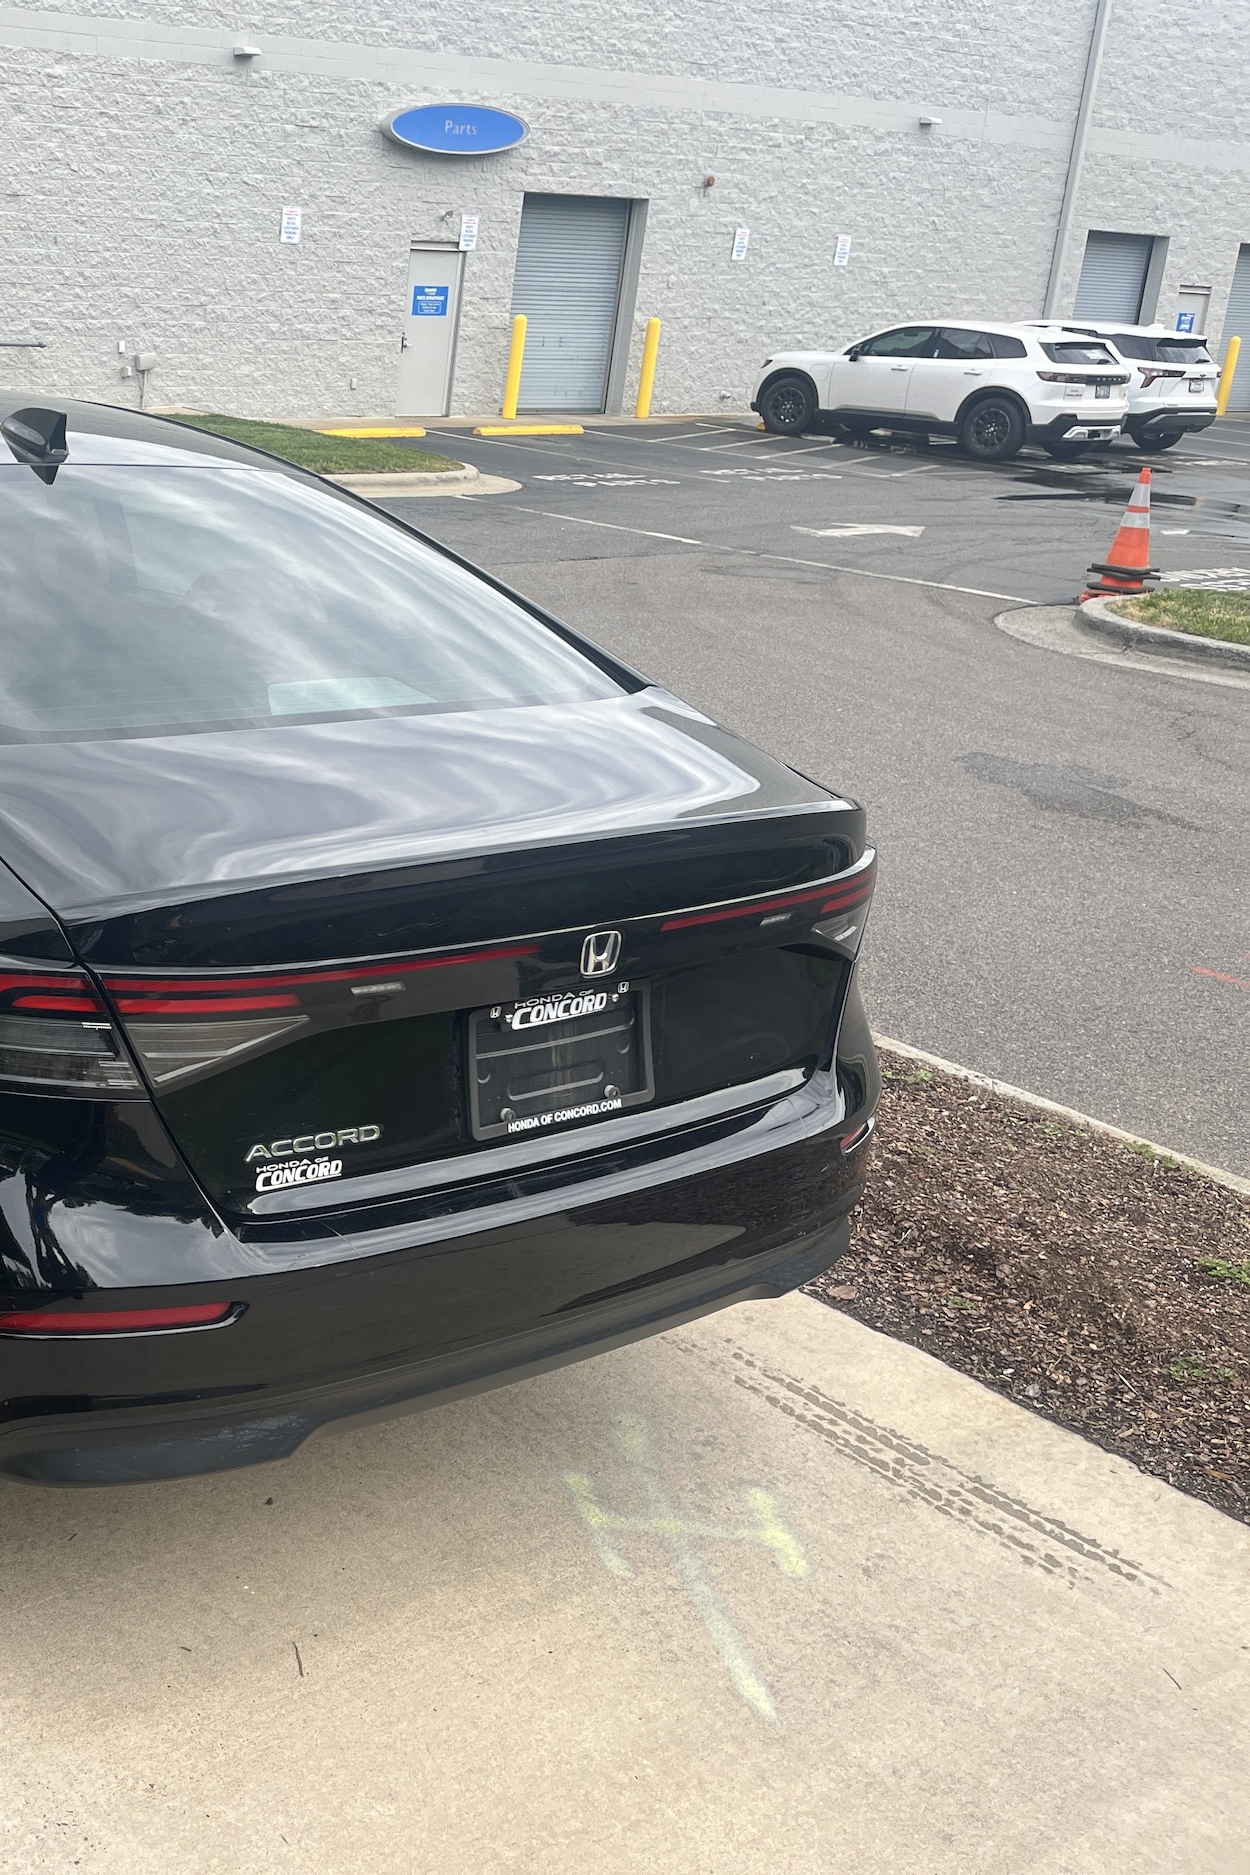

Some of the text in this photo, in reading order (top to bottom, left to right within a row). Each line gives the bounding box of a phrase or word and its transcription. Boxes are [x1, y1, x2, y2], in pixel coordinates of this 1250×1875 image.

[444, 119, 477, 135] Parts
[511, 992, 608, 1030] CONCORD
[514, 989, 595, 1009] HONDA OF
[507, 1098, 622, 1133] HONDA OF CONCORD.COM
[244, 1125, 382, 1162] ACCORD
[255, 1159, 343, 1193] CONCORD
[256, 1159, 312, 1174] HONDA
